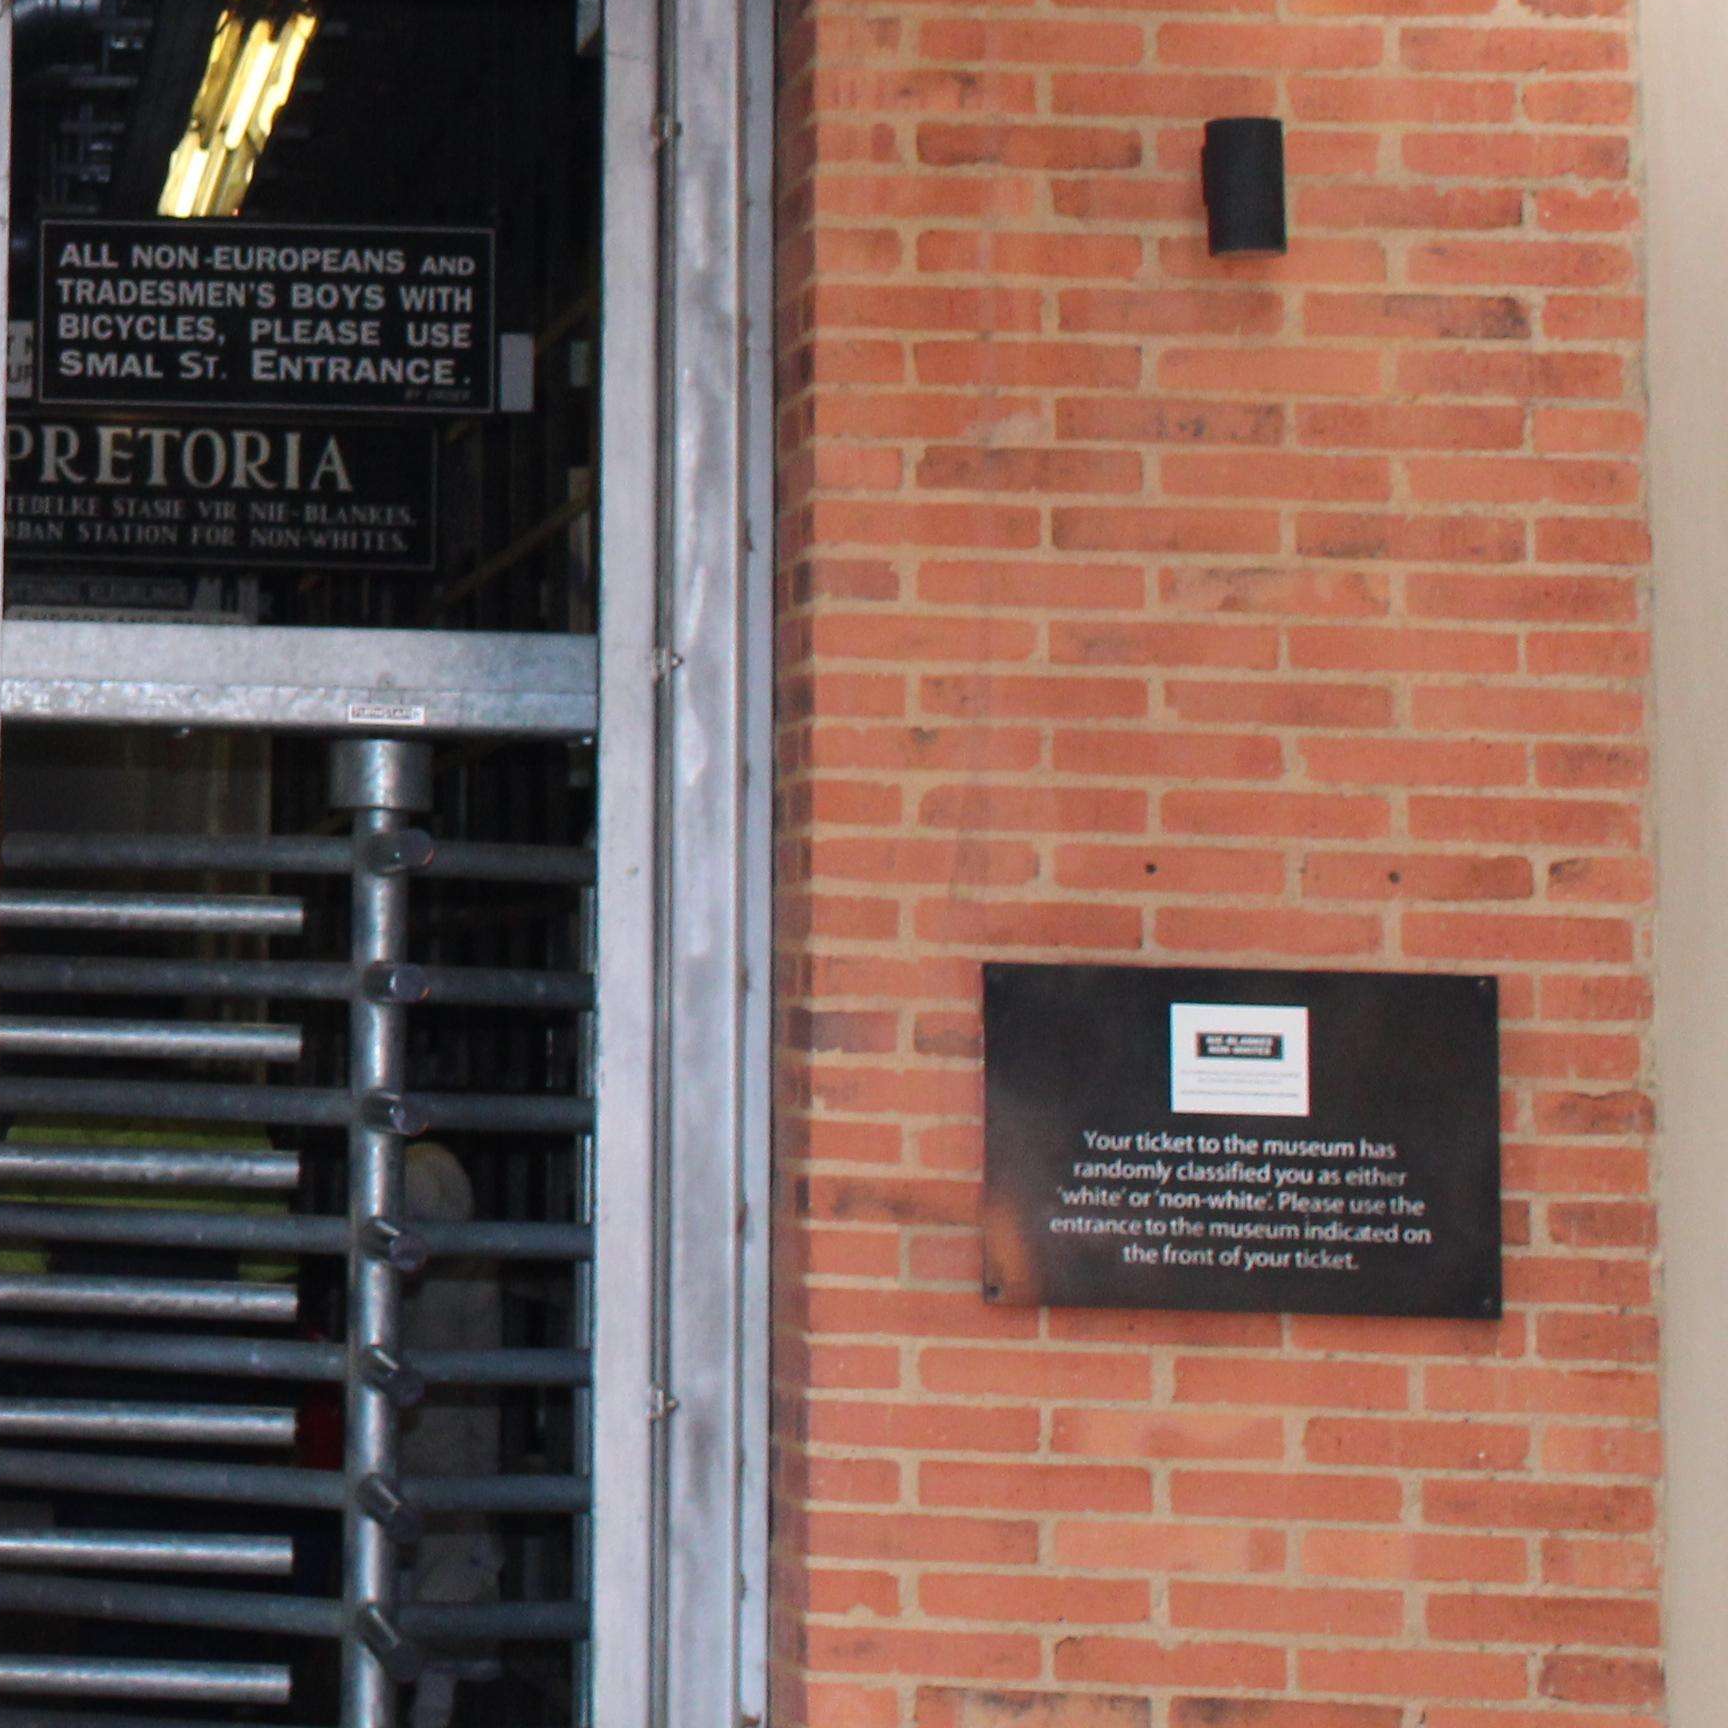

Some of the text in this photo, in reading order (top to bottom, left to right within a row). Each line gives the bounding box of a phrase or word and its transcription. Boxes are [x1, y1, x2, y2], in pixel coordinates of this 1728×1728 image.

[59, 242, 119, 269] ALL
[420, 256, 476, 276] AND
[57, 277, 473, 313] TRADESMEN'S BOYS WITH
[58, 312, 472, 349] BICYCLES, PLEASE USE
[59, 349, 164, 378] SMAL
[5, 424, 352, 491] PRETORIA
[199, 500, 236, 520] VIR
[77, 522, 178, 544] STATION
[190, 524, 235, 547] FOR
[1082, 1129, 1397, 1159] Your ticket to the museum has
[1073, 1158, 1407, 1187] randomly classified you as either
[1128, 1190, 1152, 1208] or
[1278, 1191, 1345, 1214] Please
[1348, 1198, 1386, 1215] use
[1389, 1195, 1426, 1217] the
[1049, 1215, 1433, 1244] entrance to the museum indicated on
[1122, 1242, 1360, 1271] the front of your ticket.
